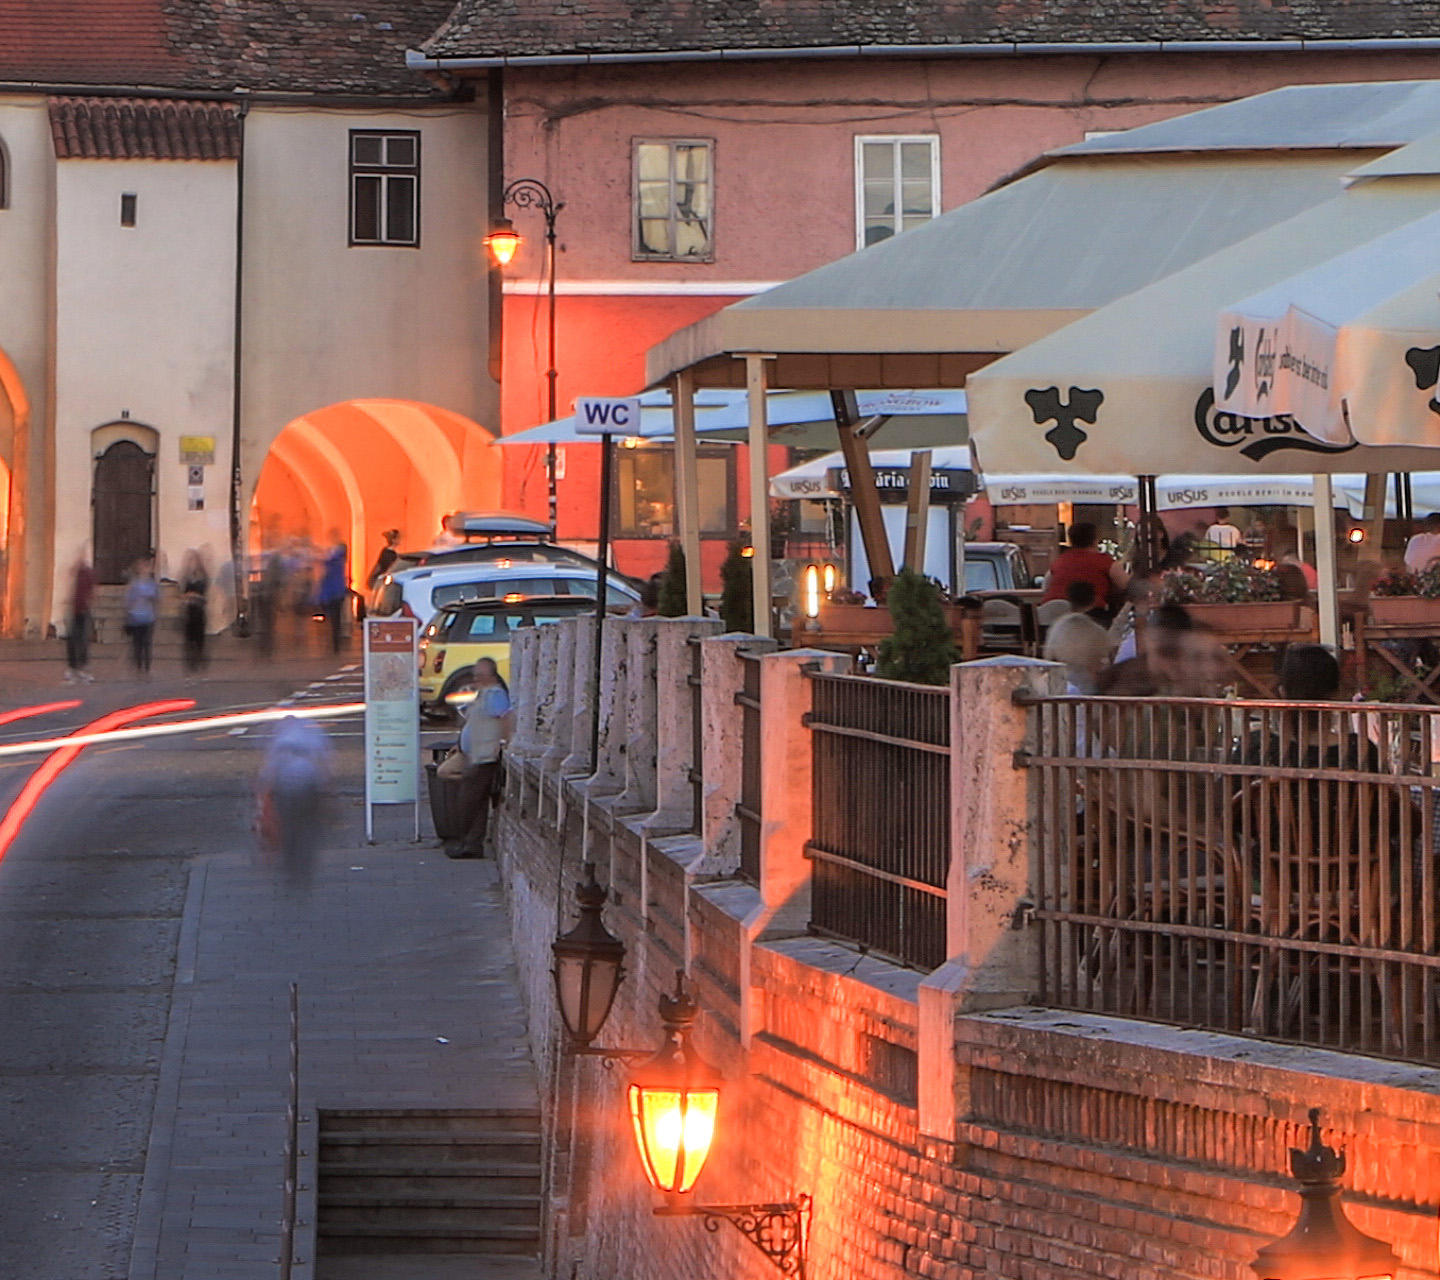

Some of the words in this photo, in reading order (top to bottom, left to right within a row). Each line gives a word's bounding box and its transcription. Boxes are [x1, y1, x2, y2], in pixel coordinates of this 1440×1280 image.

[584, 403, 629, 426] WC
[791, 480, 822, 494] URSUS
[1001, 482, 1026, 500] URSUS
[1109, 482, 1133, 500] URSUS
[1168, 489, 1208, 505] URSUS
